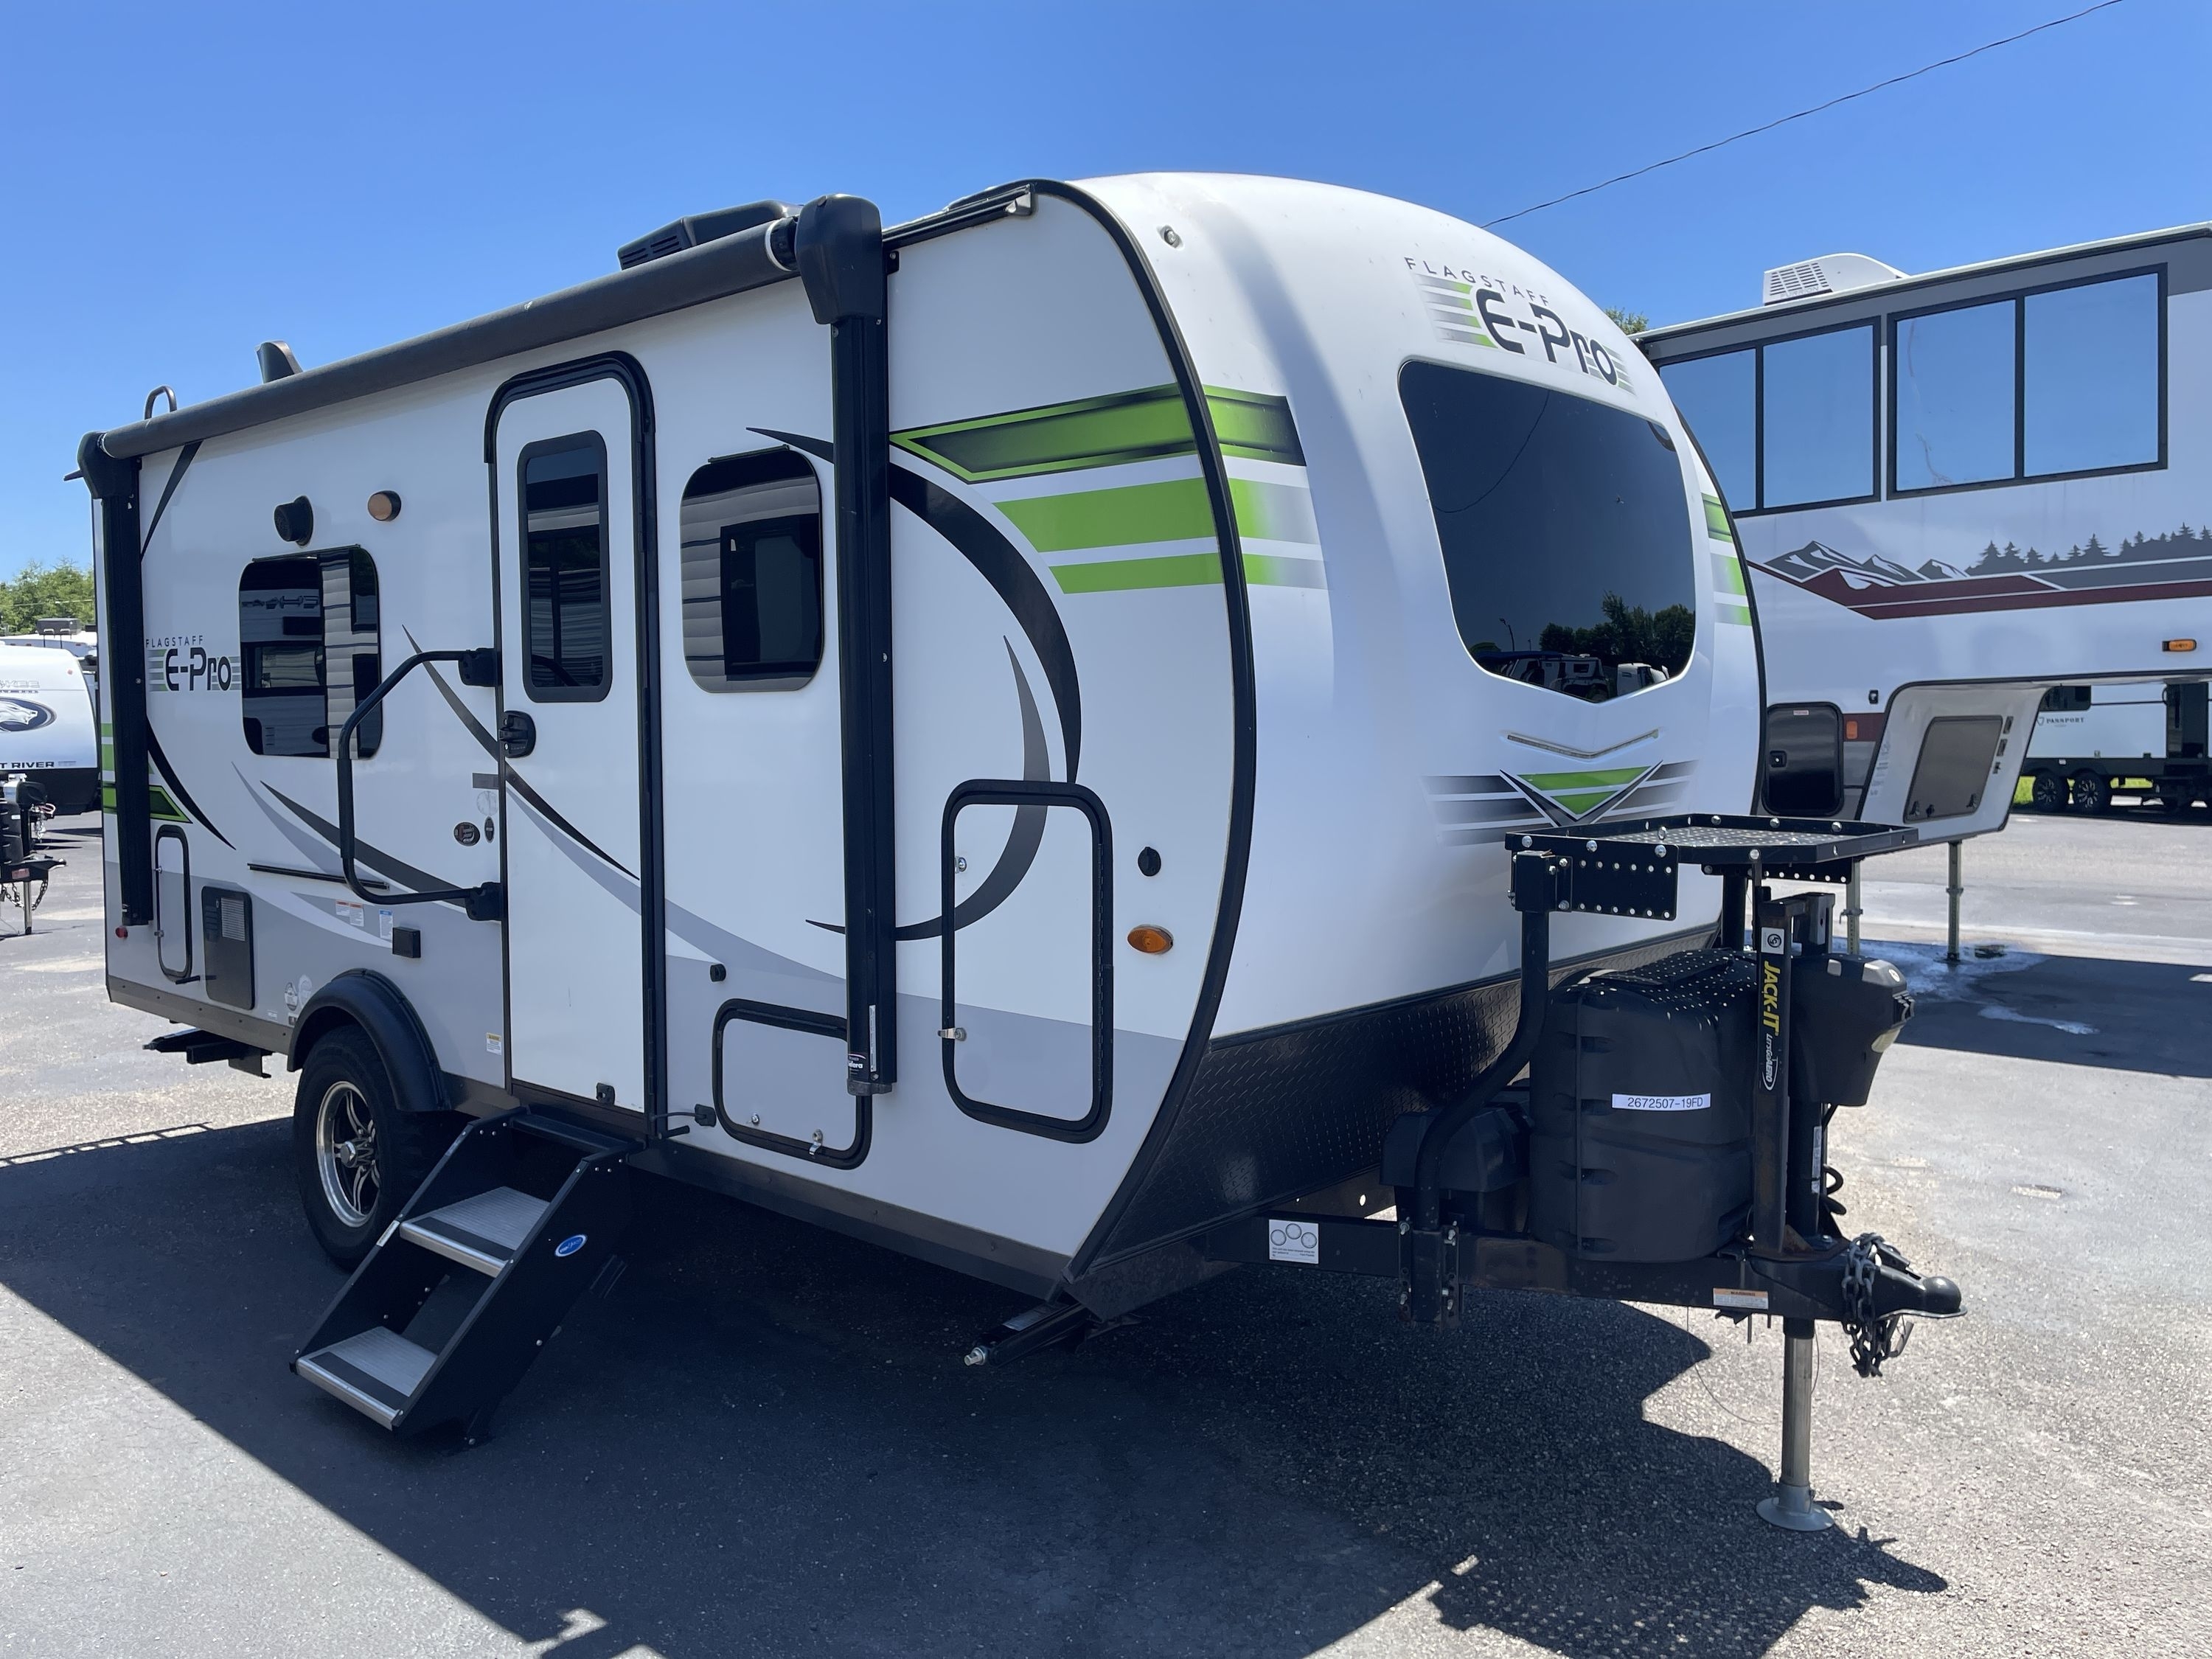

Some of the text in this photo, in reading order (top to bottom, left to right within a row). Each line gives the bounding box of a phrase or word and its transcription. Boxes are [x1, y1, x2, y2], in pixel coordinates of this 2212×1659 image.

[1404, 257, 1549, 306] FLAGSTAFF
[1475, 288, 1618, 386] E-Pro
[145, 635, 204, 648] FLAGSTAFF
[165, 647, 232, 692] E-Pro
[1763, 961, 1781, 1034] JACK-IT
[1627, 1096, 1703, 1109] 2672507-19FD
